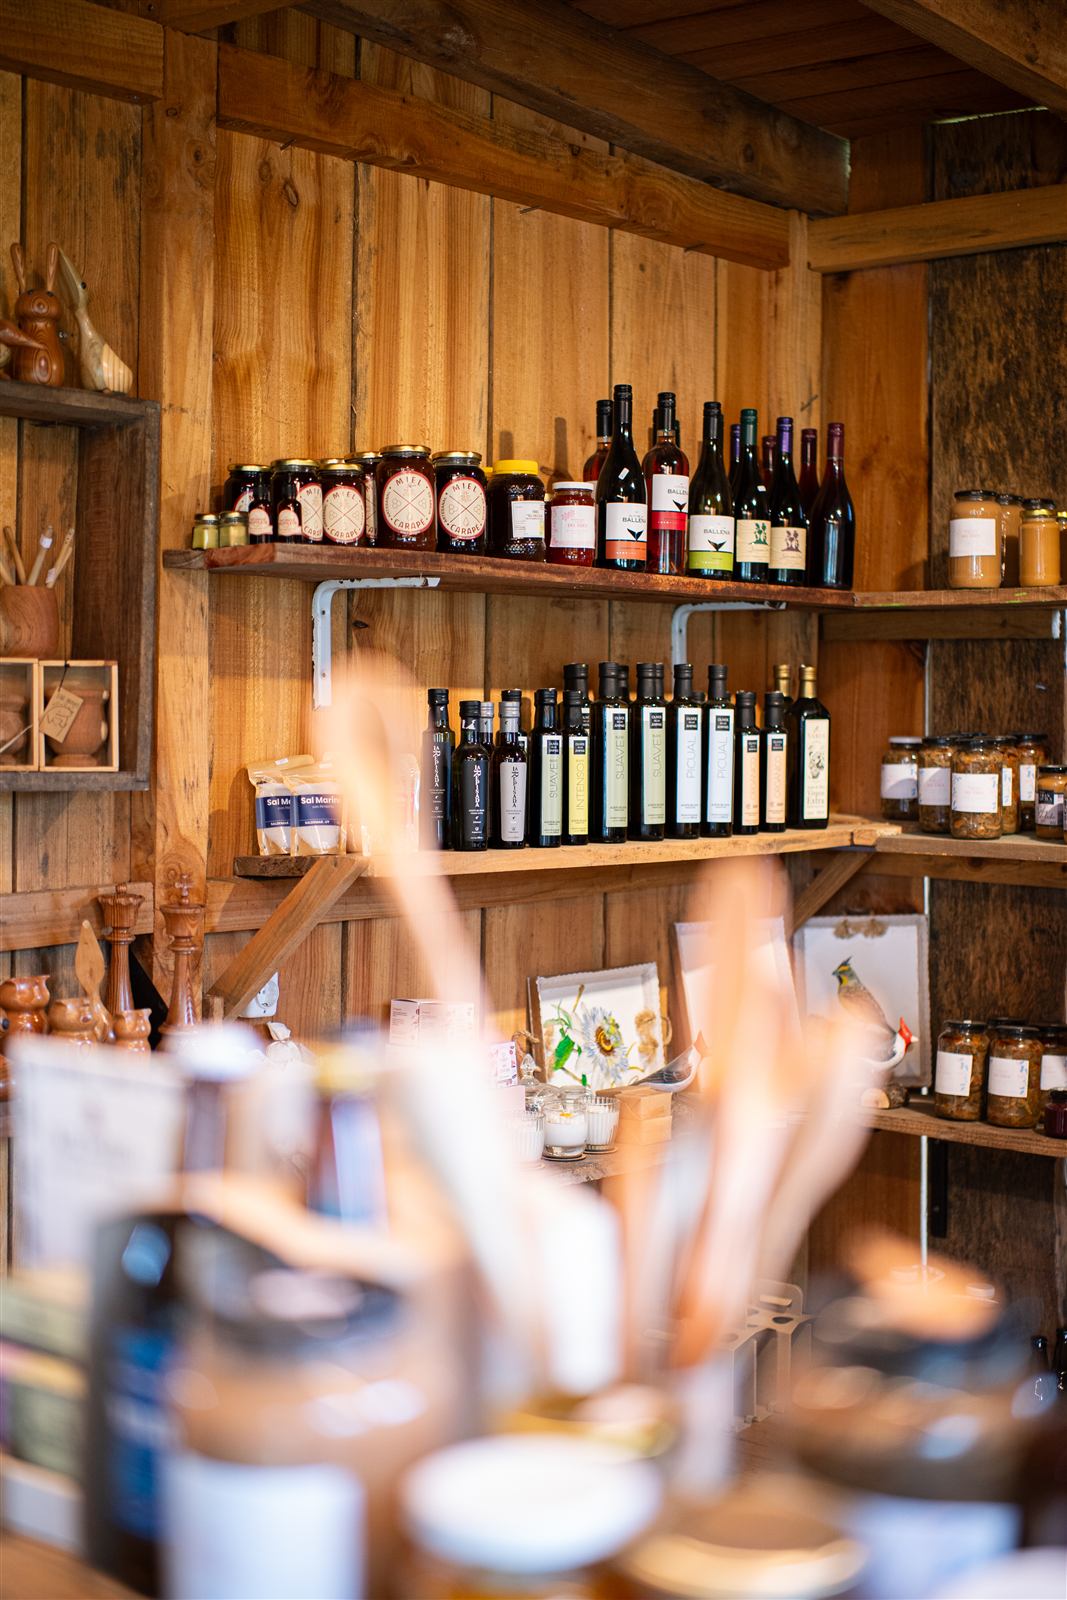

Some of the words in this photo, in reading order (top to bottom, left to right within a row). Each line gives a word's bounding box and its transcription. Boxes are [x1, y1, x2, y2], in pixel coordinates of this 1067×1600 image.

[332, 491, 356, 500] MIEL
[395, 476, 422, 486] MIEL
[452, 482, 477, 493] MIEL
[616, 741, 625, 780] SUAVE
[653, 739, 662, 777] SUAVE
[686, 736, 697, 779] PICUAL
[717, 736, 728, 779] PICUAL
[549, 762, 558, 799] SUAVE
[576, 763, 585, 810] INTENSO
[300, 797, 314, 805] Sal
